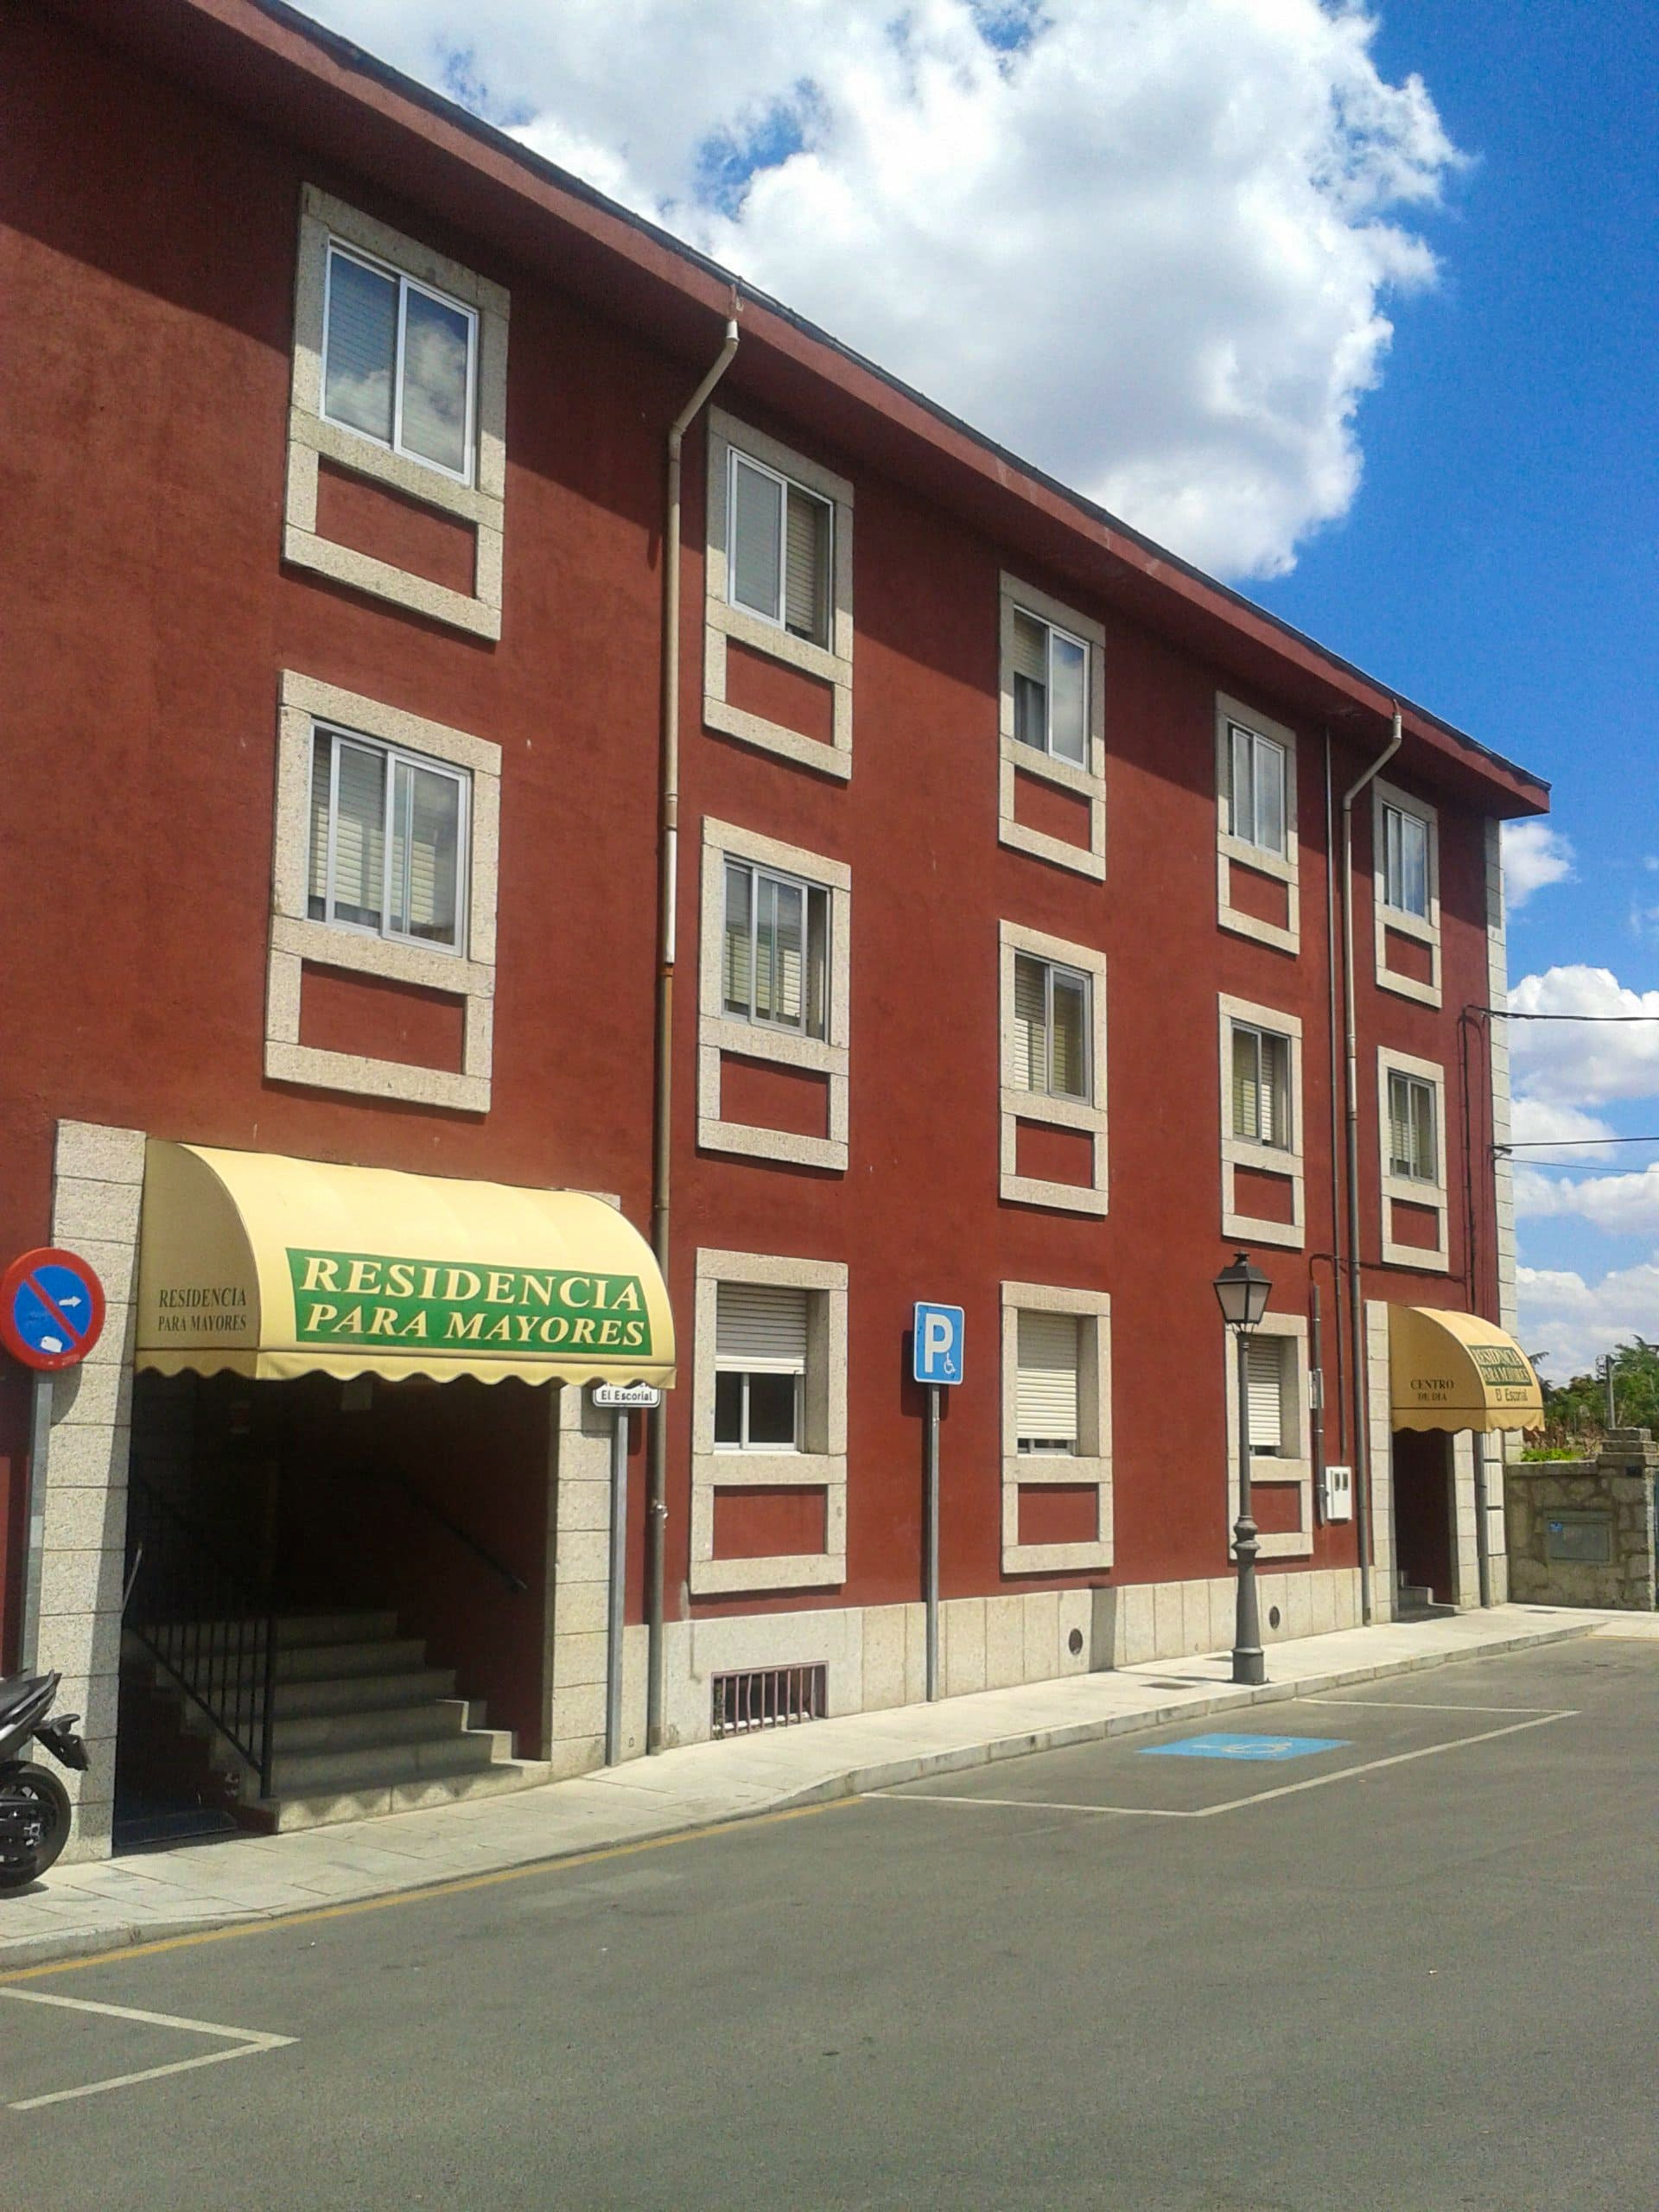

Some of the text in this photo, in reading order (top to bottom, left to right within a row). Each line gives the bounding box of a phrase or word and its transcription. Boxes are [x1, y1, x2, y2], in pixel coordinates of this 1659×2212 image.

[299, 1256, 641, 1311] RESIDENCIA
[159, 1287, 247, 1307] RESIDENCIA
[158, 1314, 247, 1332] PARA MAYORES
[304, 1303, 645, 1346] PARA MAYORES
[925, 1313, 953, 1373] P
[1410, 1379, 1454, 1389] CENTRO
[601, 1389, 653, 1402] El Escorial
